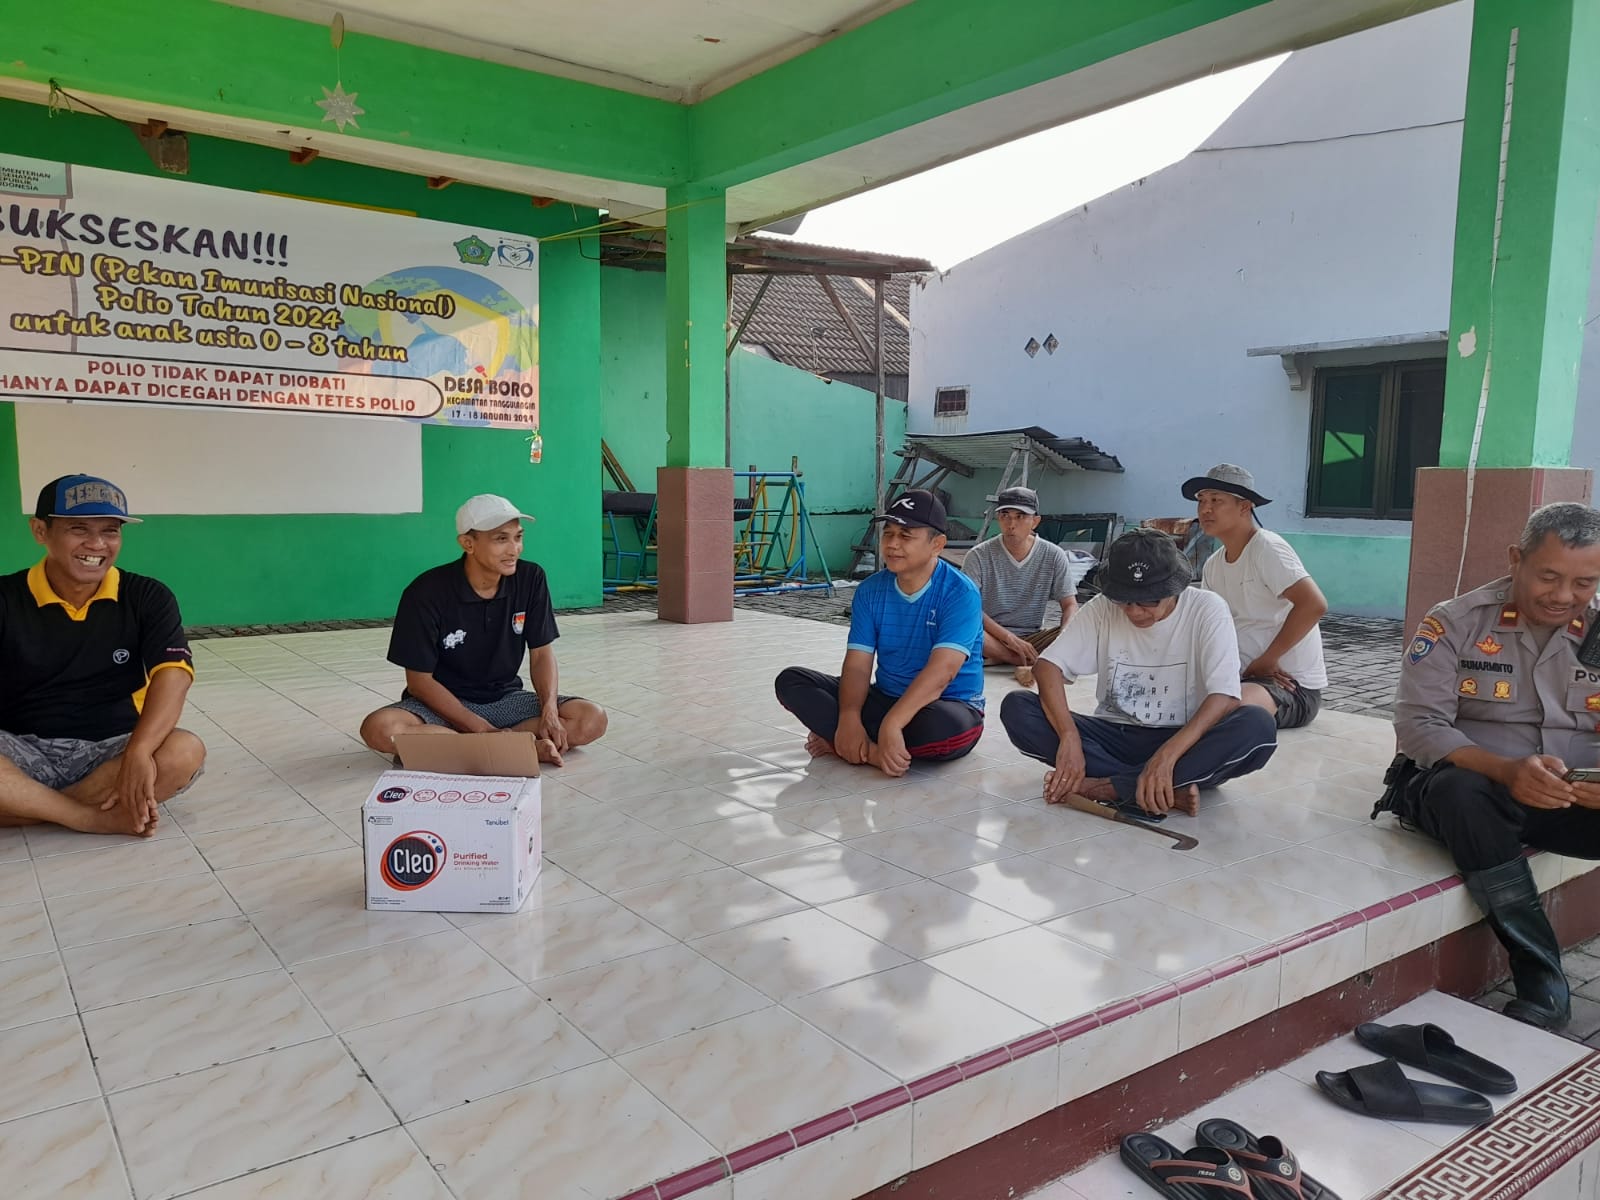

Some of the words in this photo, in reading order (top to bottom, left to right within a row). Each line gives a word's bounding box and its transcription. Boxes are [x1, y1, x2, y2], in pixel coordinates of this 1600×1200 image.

[0, 167, 51, 179] MENTERIAN
[0, 204, 288, 267] UKSESKAN!!!
[91, 253, 198, 290] (Pekan
[201, 268, 336, 304] Imunisasi
[340, 284, 456, 319] Nasional)
[94, 285, 173, 315] Polio
[176, 293, 269, 324] Tahun
[274, 303, 344, 330] 2024
[10, 311, 110, 337] untuk
[114, 319, 194, 344] anak
[196, 326, 257, 350] usia
[260, 329, 281, 350] 0
[309, 333, 329, 356] 8
[332, 337, 409, 363] tahun
[88, 360, 146, 377] POLIO
[151, 364, 208, 382] TIDAK
[214, 369, 274, 386] DAPAT
[279, 374, 346, 391] DIOBATI
[75, 378, 142, 396] DAPAT
[147, 383, 231, 402] DICEGAH
[236, 388, 310, 406] DENGAN
[314, 393, 366, 409] TETES
[370, 397, 416, 412] POLIO
[444, 376, 483, 394] DESA
[489, 379, 533, 398] BORO
[446, 396, 488, 407] KECAMATAN
[489, 399, 536, 410] TANGGULANGIN
[451, 410, 461, 418] 17
[479, 412, 512, 421] JANUARI
[513, 414, 534, 423] 2024
[1575, 668, 1600, 683] PO
[1132, 700, 1162, 709] THE
[1131, 711, 1175, 721] ARTH
[383, 790, 404, 799] Cleo
[393, 848, 434, 874] Cleo
[453, 852, 488, 860] Purified
